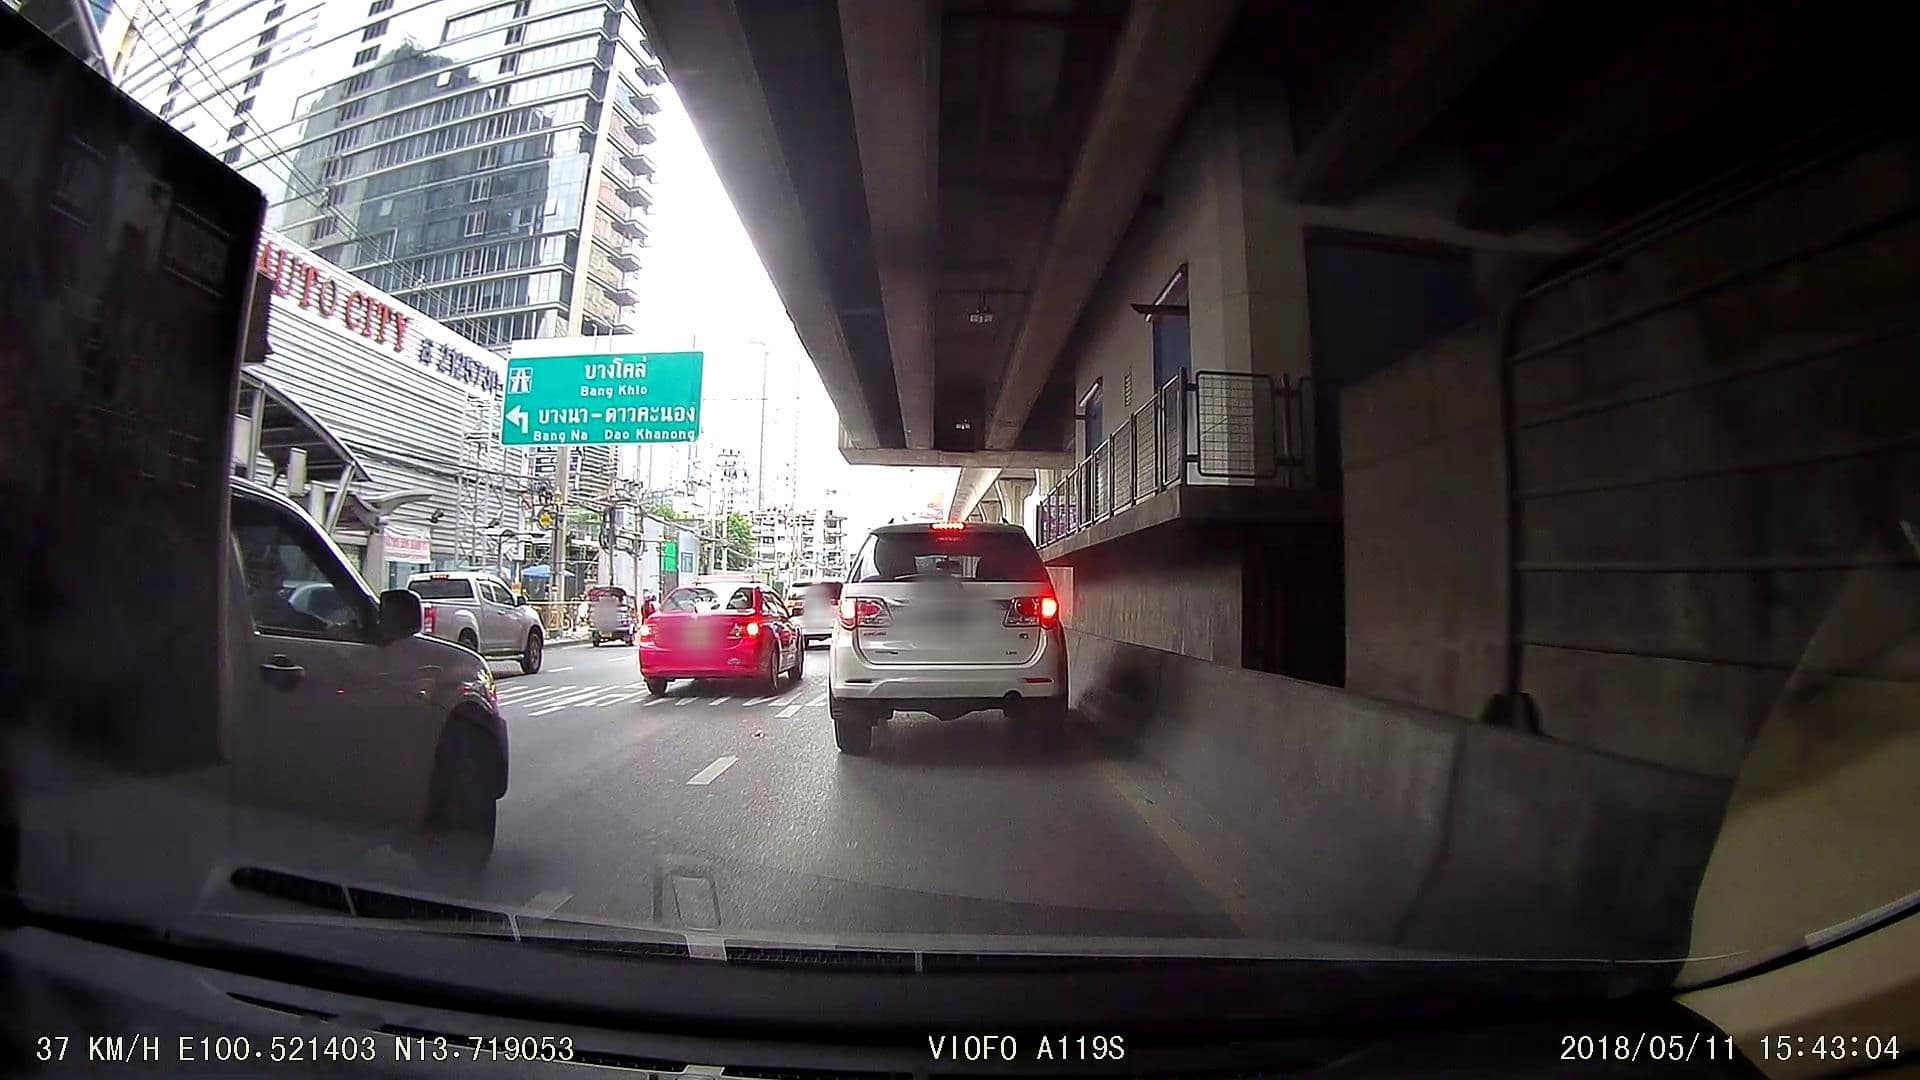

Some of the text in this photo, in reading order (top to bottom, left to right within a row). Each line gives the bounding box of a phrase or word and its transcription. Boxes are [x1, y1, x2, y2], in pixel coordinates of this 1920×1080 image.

[345, 290, 412, 352] CITY
[585, 356, 648, 380] บางโคล่
[580, 384, 648, 398] Bang Khlo
[533, 430, 588, 442] Bang Na
[604, 428, 696, 442] Dao Khanong
